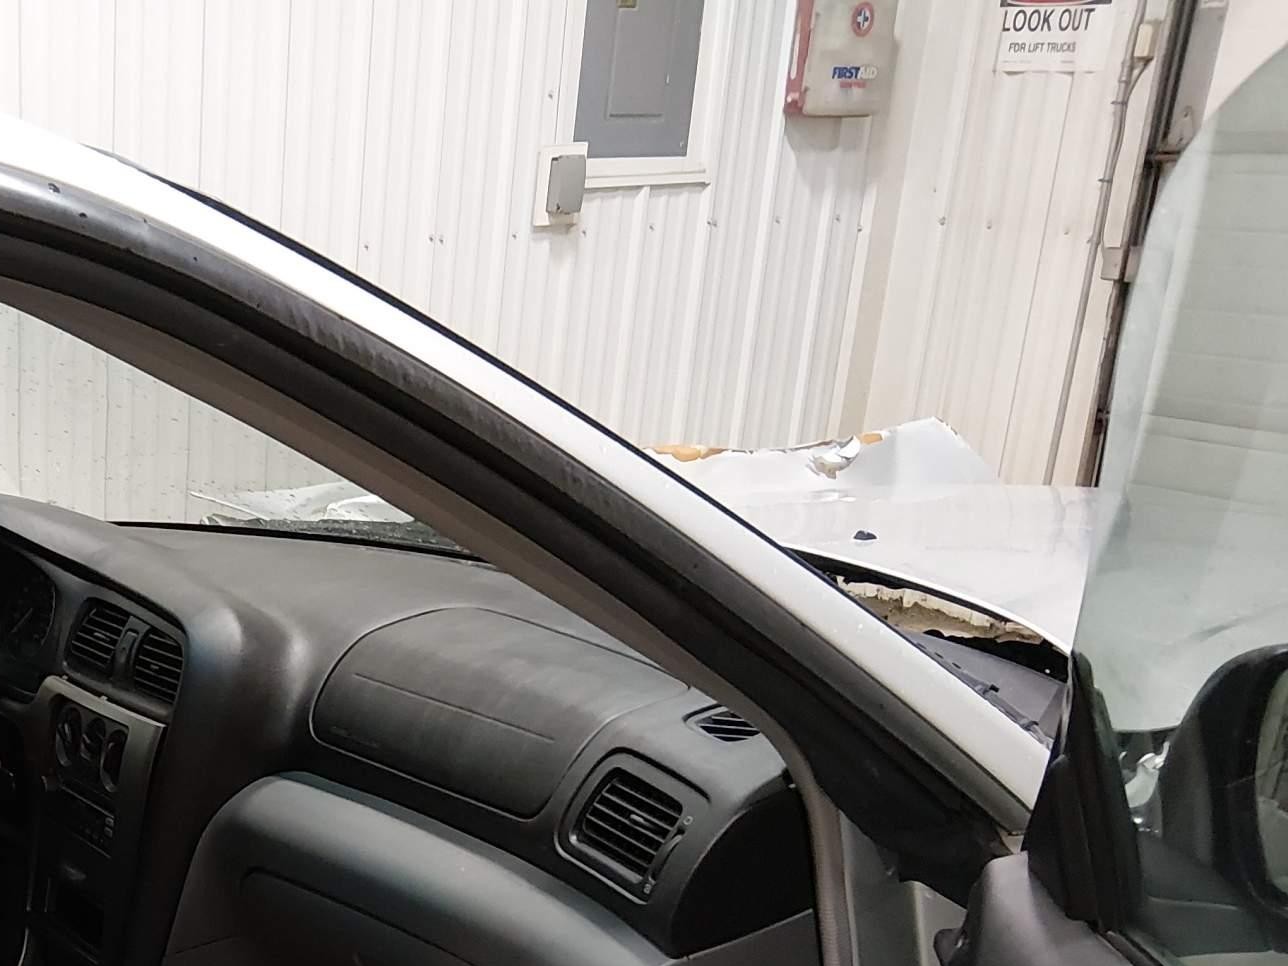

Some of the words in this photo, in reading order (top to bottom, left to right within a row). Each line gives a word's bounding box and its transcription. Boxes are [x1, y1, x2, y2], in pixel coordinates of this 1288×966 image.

[1002, 9, 1055, 32] LOOK
[1058, 8, 1096, 32] OUT
[1008, 43, 1026, 53] FOR
[1028, 43, 1045, 53] LIFT
[1047, 42, 1077, 53] TRUCKS
